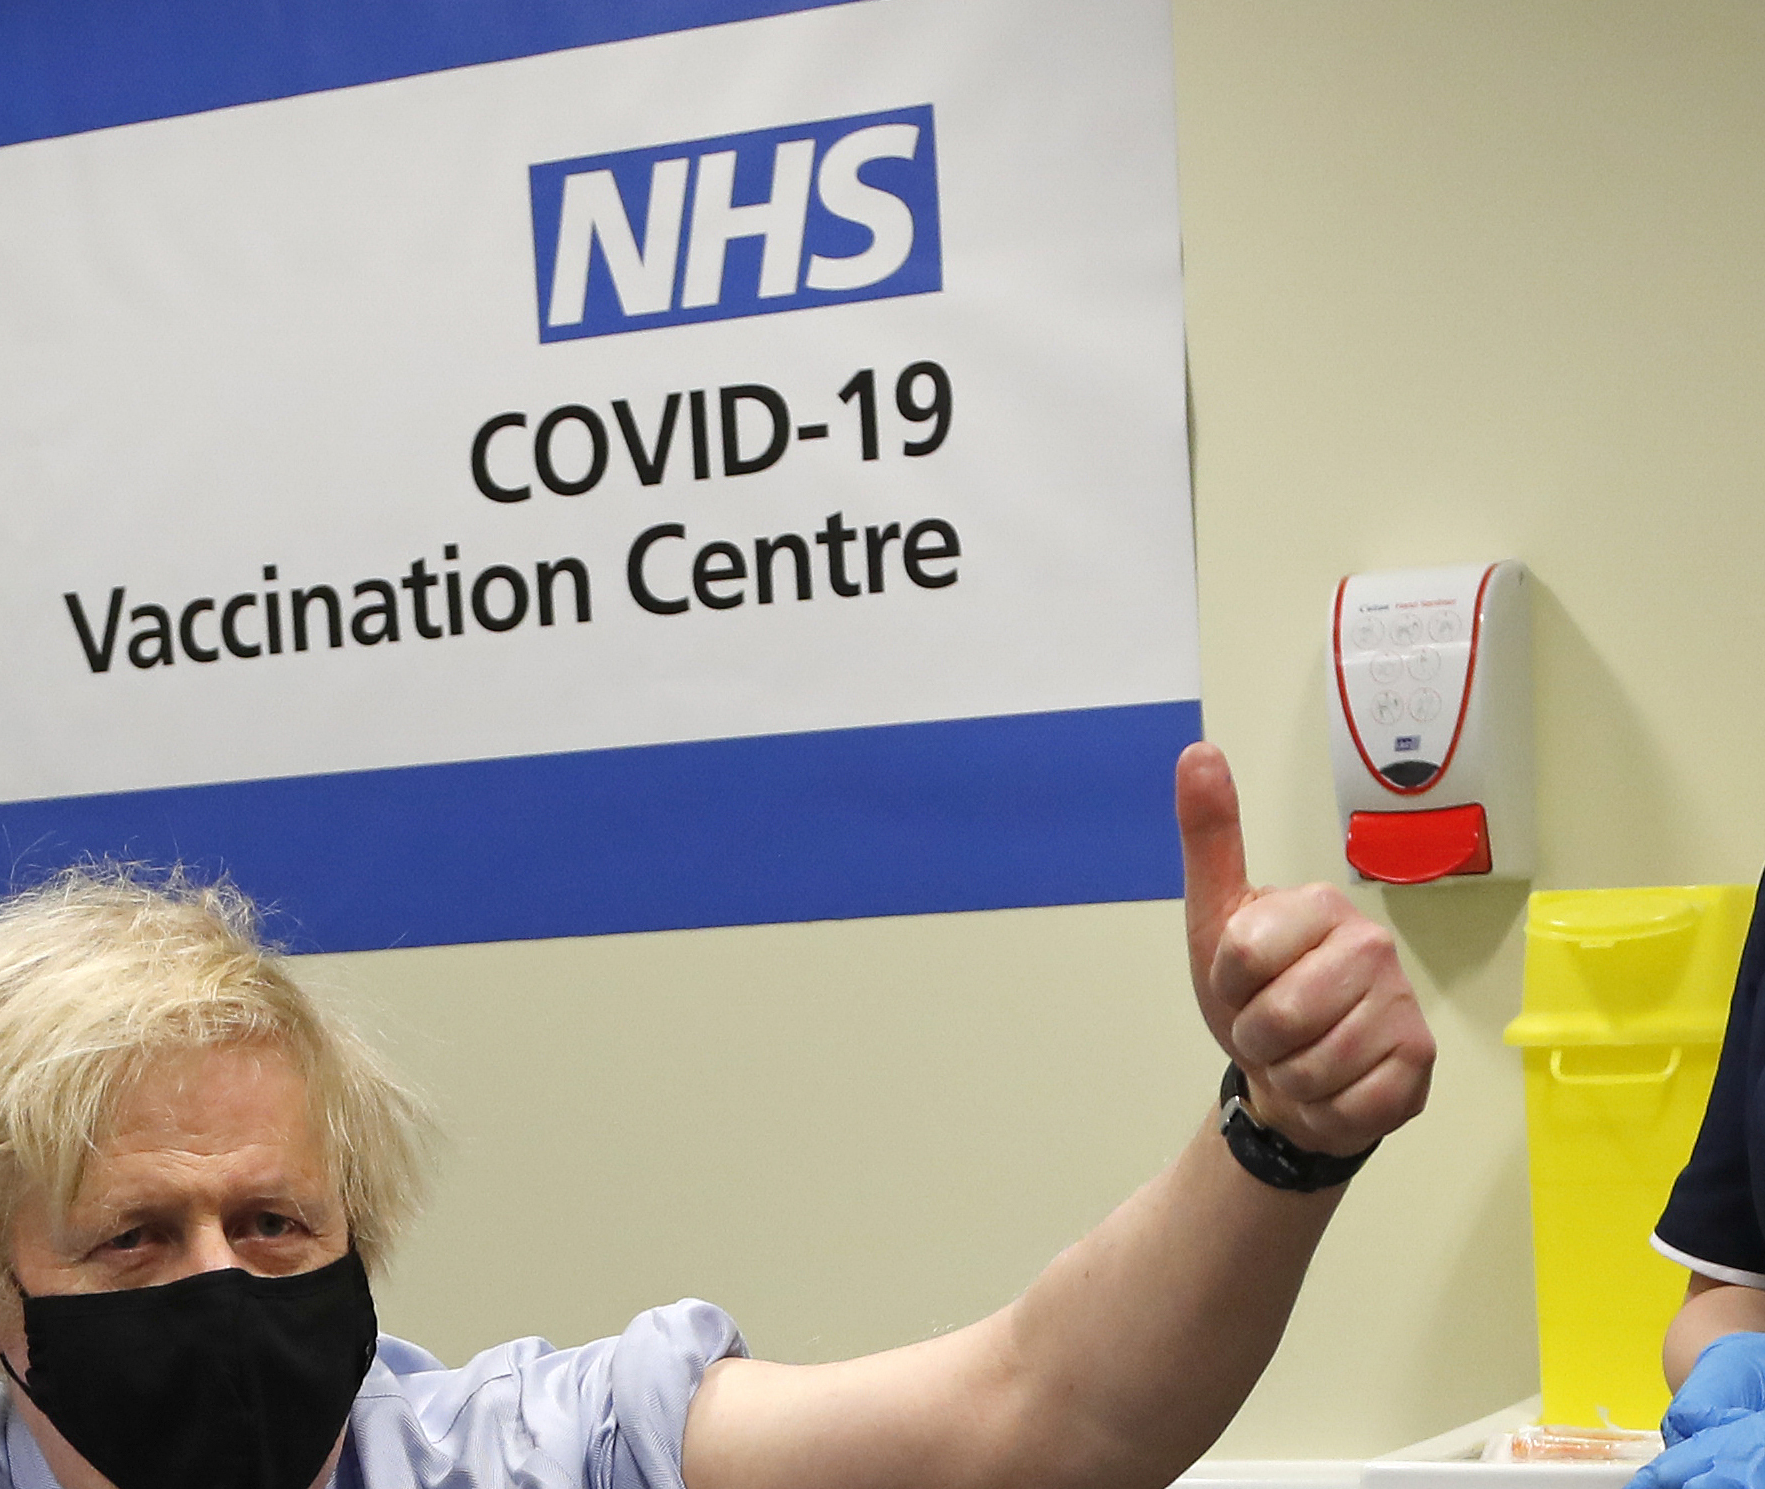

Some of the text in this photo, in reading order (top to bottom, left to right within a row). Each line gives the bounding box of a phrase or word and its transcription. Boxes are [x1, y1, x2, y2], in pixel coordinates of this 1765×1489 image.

[546, 122, 920, 327] NHS
[469, 360, 953, 503] COVID-19
[63, 511, 963, 675] Vaccination Centre
